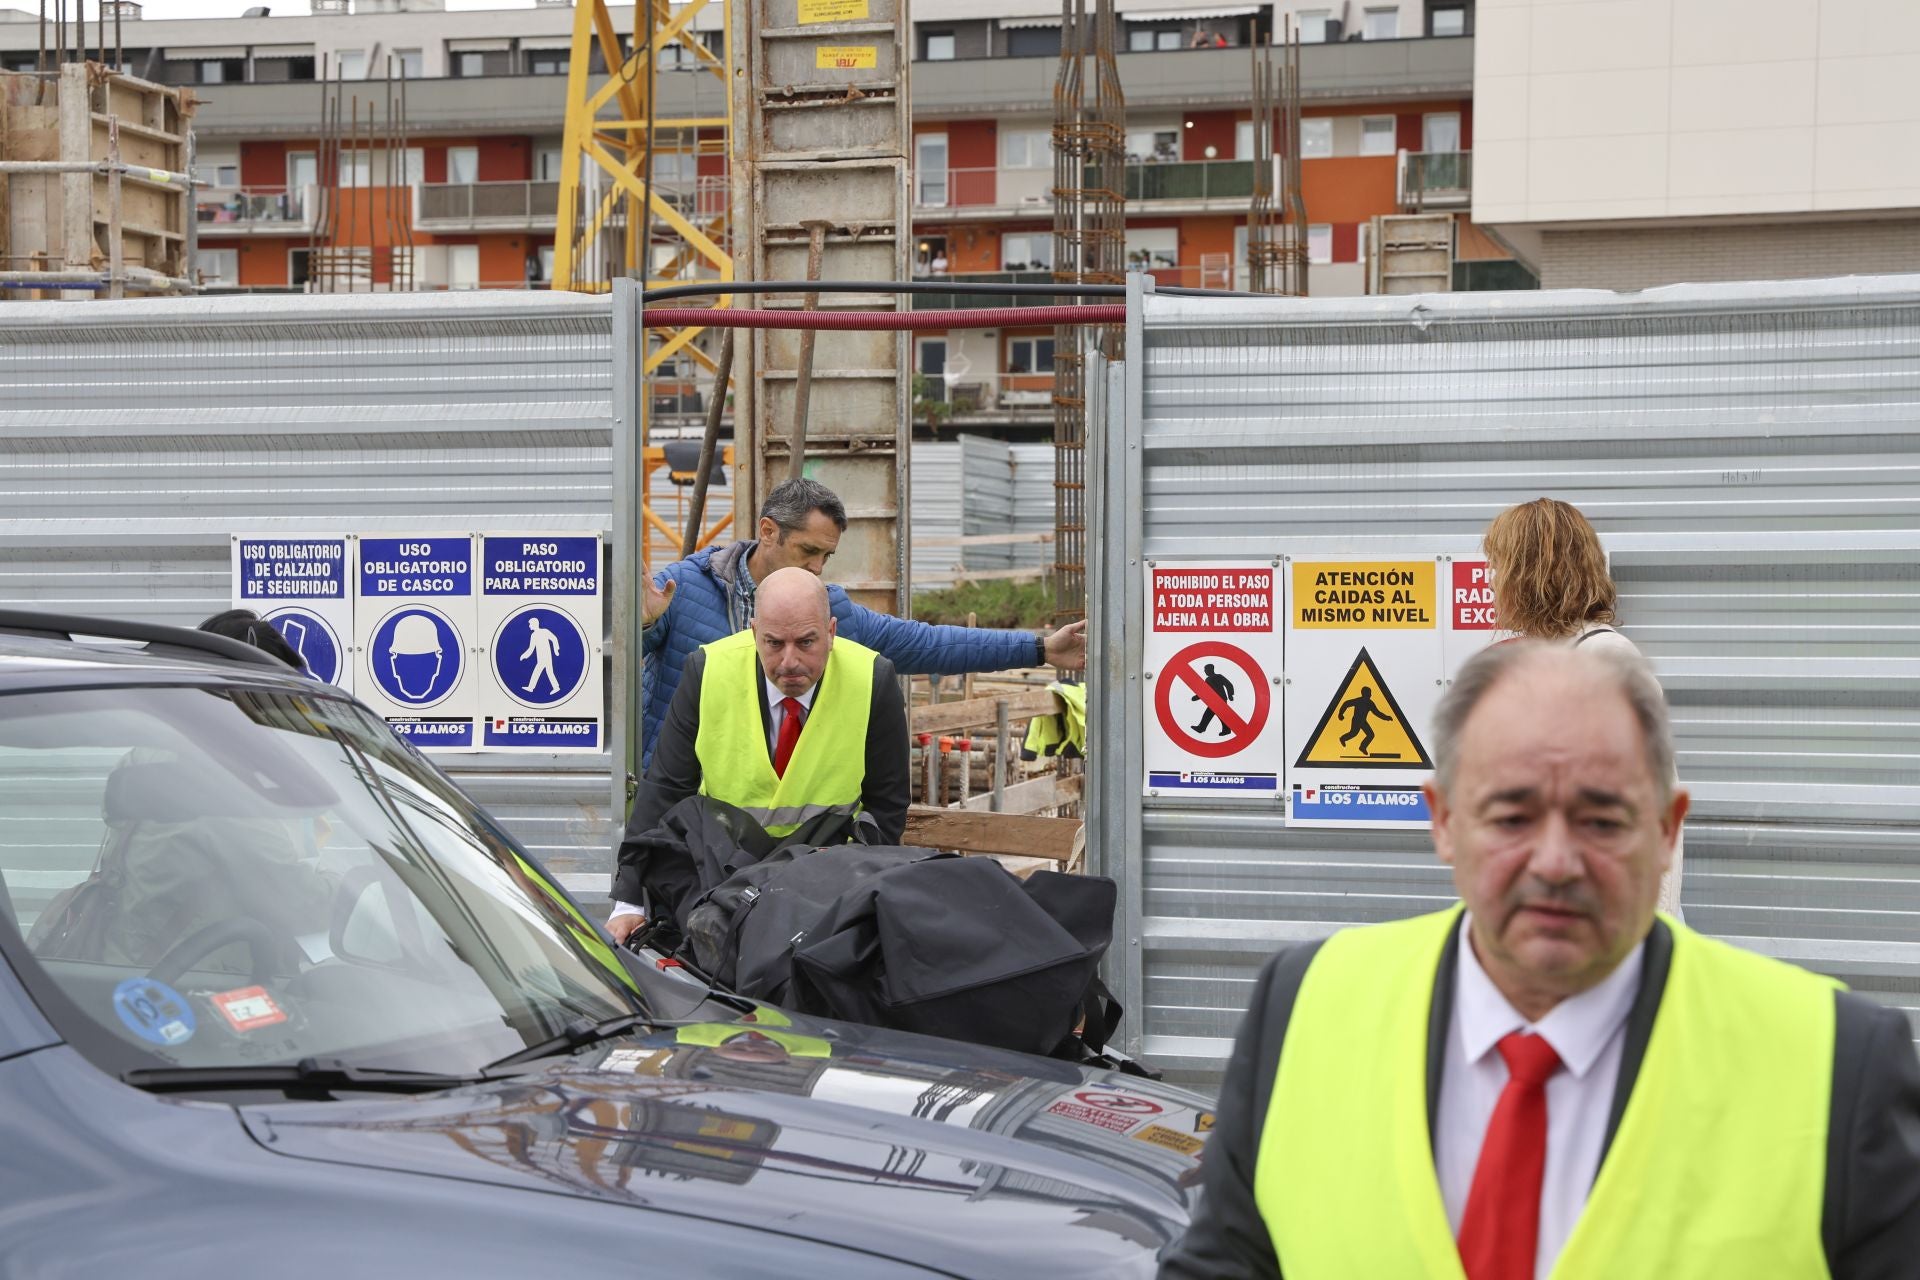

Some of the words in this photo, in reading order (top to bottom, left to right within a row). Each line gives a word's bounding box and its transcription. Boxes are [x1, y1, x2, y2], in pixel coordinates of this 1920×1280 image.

[243, 545, 266, 559] USO
[269, 544, 342, 559] OBLIGATORIO
[399, 543, 431, 556] USO
[522, 543, 558, 556] PASO
[254, 563, 271, 576] DE
[274, 562, 331, 577] CALZADO
[364, 561, 467, 574] OBLIGATORIO
[495, 560, 586, 573] OBLIGATORIO
[485, 577, 520, 590] PARA
[523, 577, 595, 590] PERSONAS
[1156, 575, 1219, 589] PROHIBIDO
[1222, 575, 1236, 589] EL
[1239, 575, 1270, 589] PASO
[1315, 568, 1414, 586] ATENCIÓN
[247, 580, 264, 594] DE
[267, 580, 338, 595] SEGURIDAD
[378, 579, 397, 591] DE
[401, 578, 454, 591] CASCO
[1157, 594, 1167, 608] A
[1170, 594, 1204, 608] TODA
[1207, 594, 1269, 608] PERSONA
[1314, 589, 1385, 604] CAIDAS
[1391, 589, 1416, 604] AL
[1156, 612, 1198, 627] AJENA
[1200, 612, 1210, 627] A
[1213, 612, 1230, 627] LA
[1233, 612, 1270, 627] OBRA
[1301, 608, 1366, 622] MISMO
[1372, 608, 1430, 622] NIVEL
[390, 724, 411, 734] OS
[413, 724, 466, 734] ALAMOS
[512, 724, 535, 734] LOS
[537, 724, 590, 735] ALAMOS
[1193, 776, 1208, 784] LOS
[1210, 776, 1245, 784] ALAMOS
[1324, 793, 1352, 805] LOS
[1356, 793, 1419, 806] ALAMOS
